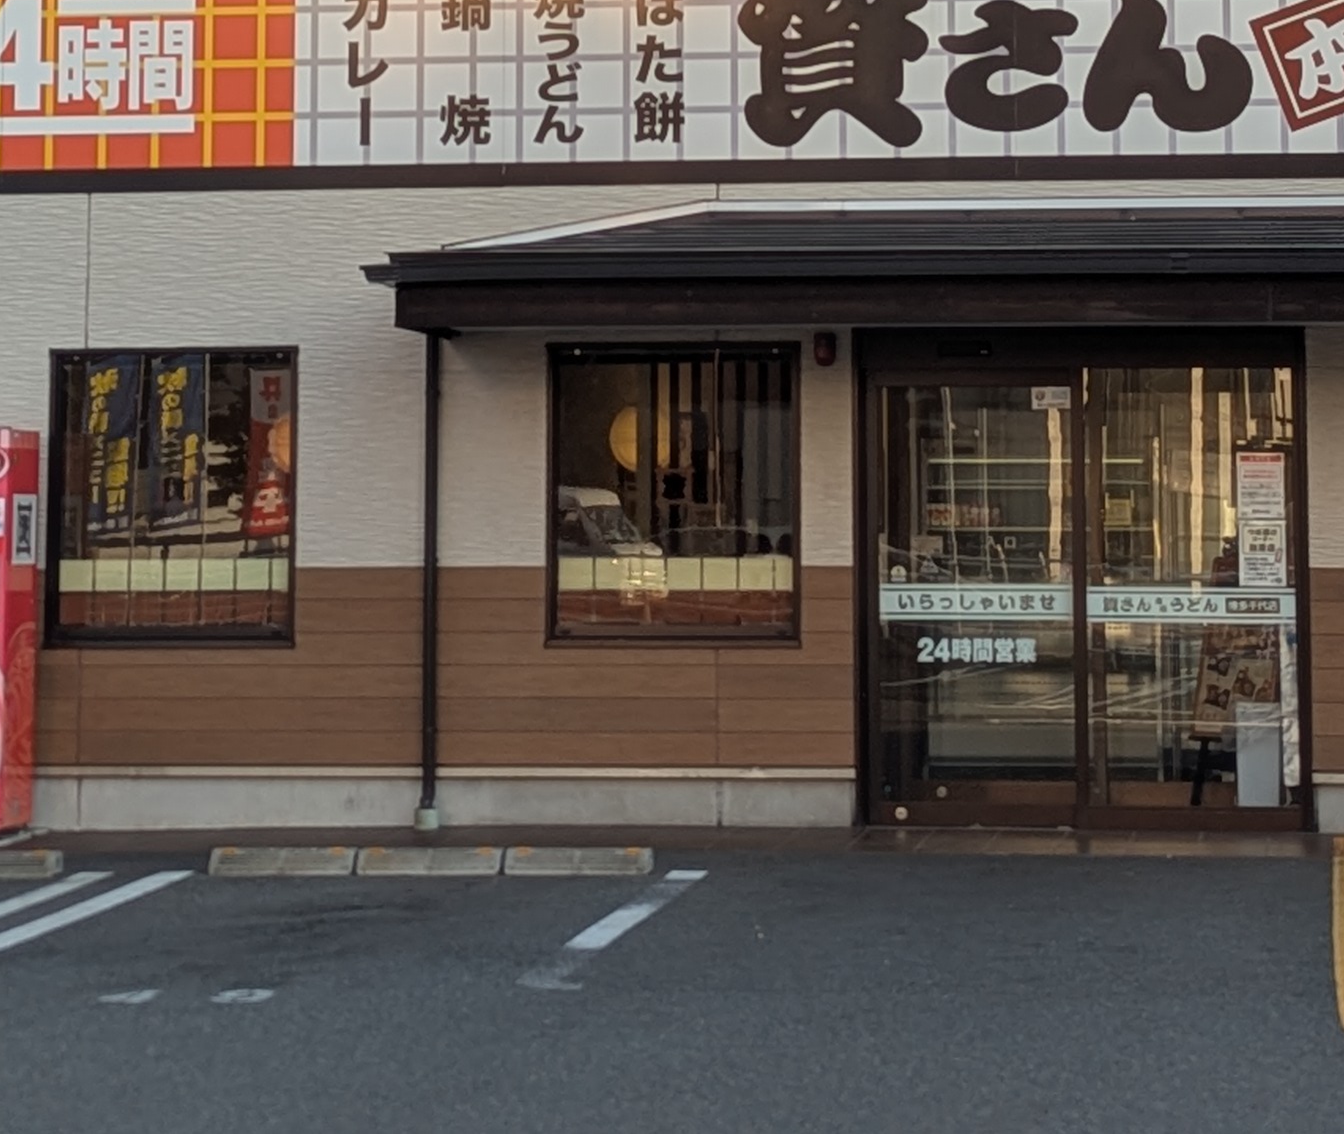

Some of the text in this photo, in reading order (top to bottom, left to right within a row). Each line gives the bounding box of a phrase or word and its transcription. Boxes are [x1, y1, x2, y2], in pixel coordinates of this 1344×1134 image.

[897, 593, 1056, 611] いらっしゃいませ
[916, 636, 1037, 664] 24時間営業
